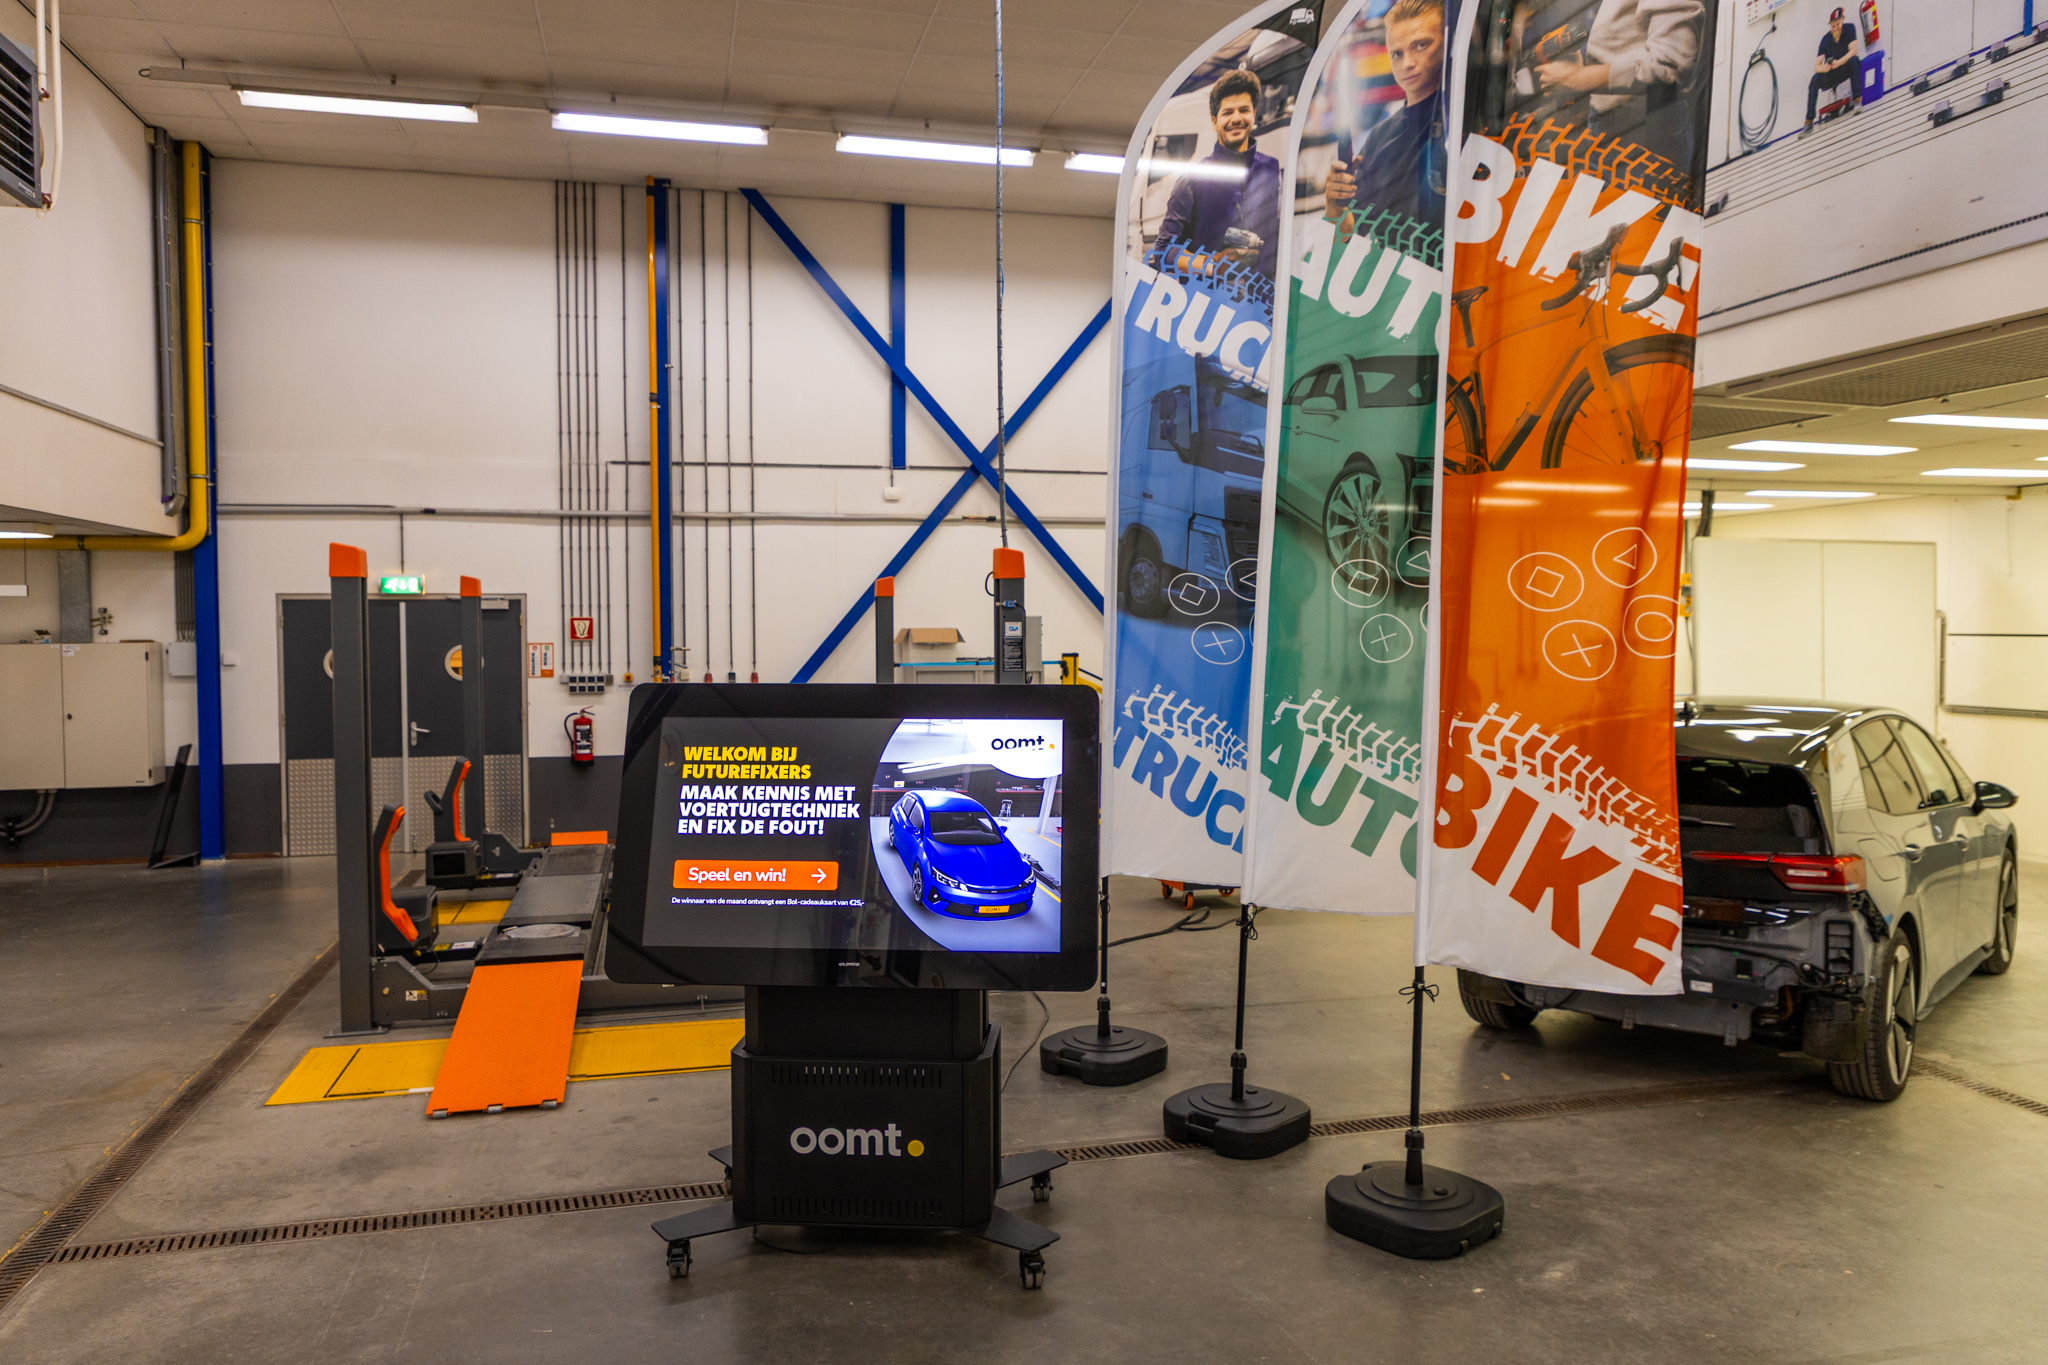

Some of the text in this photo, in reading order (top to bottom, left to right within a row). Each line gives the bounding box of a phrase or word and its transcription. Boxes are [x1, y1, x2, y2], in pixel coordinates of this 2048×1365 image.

[1454, 132, 1705, 333] BIKE
[684, 746, 797, 762] WELKOM BIJ
[682, 764, 812, 779] FUTUREFIXERS
[680, 785, 856, 801] MAAK KENNIS MET
[679, 802, 861, 818] VOERTUIGTECHNIEK
[677, 819, 825, 836] EN FIX DE FOUT!
[688, 867, 787, 884] Speel en win!
[1433, 752, 1683, 987] BIKE
[681, 897, 706, 905] winnaar
[747, 899, 775, 907] ontvangt
[787, 898, 837, 906] Bol-cadeaukaart
